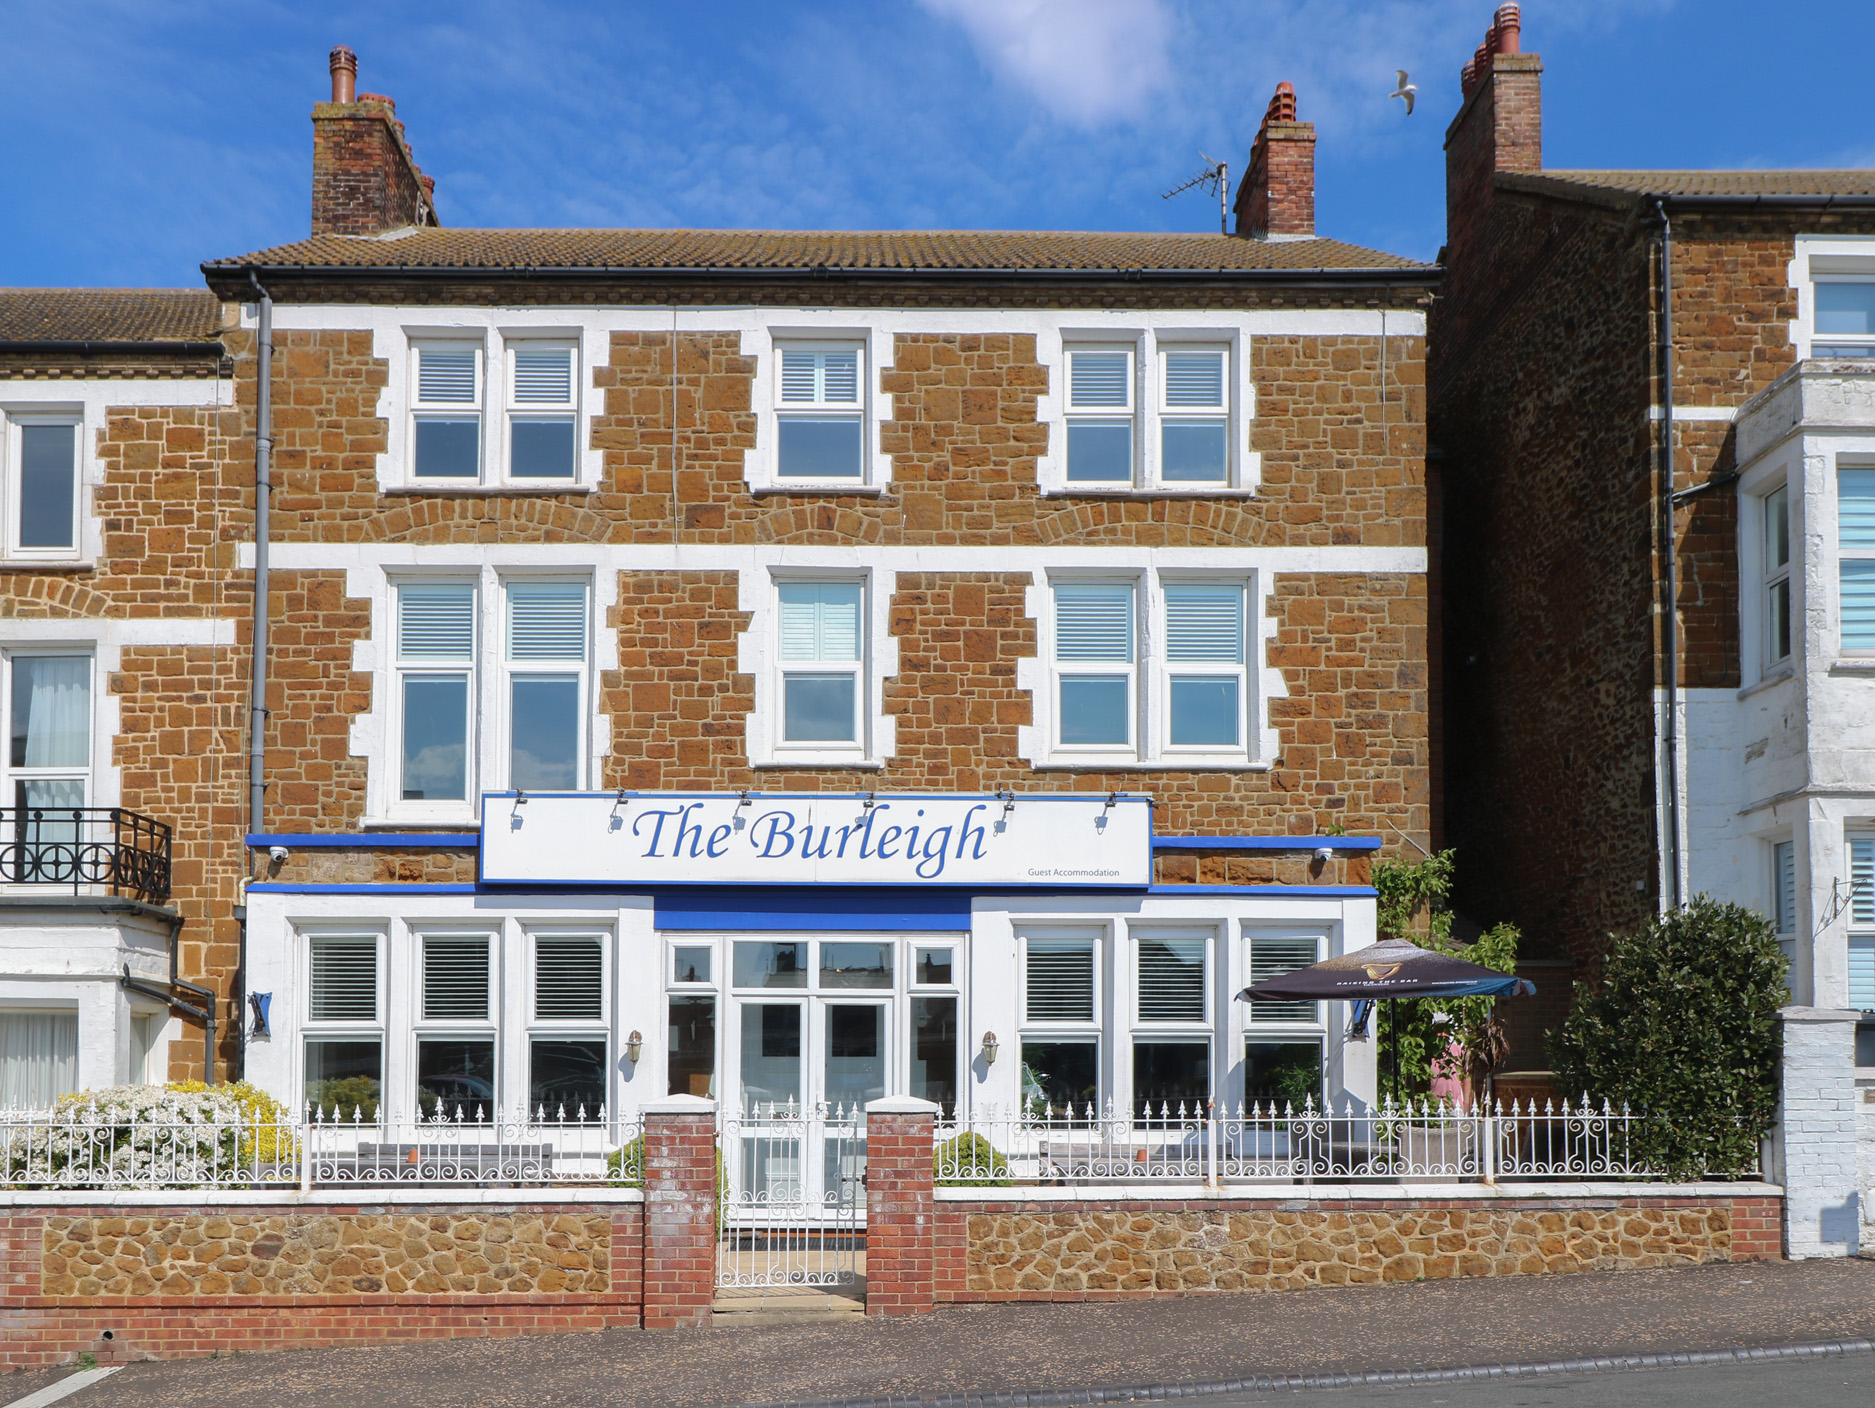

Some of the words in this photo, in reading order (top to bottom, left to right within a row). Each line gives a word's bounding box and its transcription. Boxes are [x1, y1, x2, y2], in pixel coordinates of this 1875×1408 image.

[633, 802, 731, 859] The
[749, 801, 987, 878] Burleigh
[1028, 868, 1051, 876] Guest
[1053, 868, 1120, 876] Accommodation
